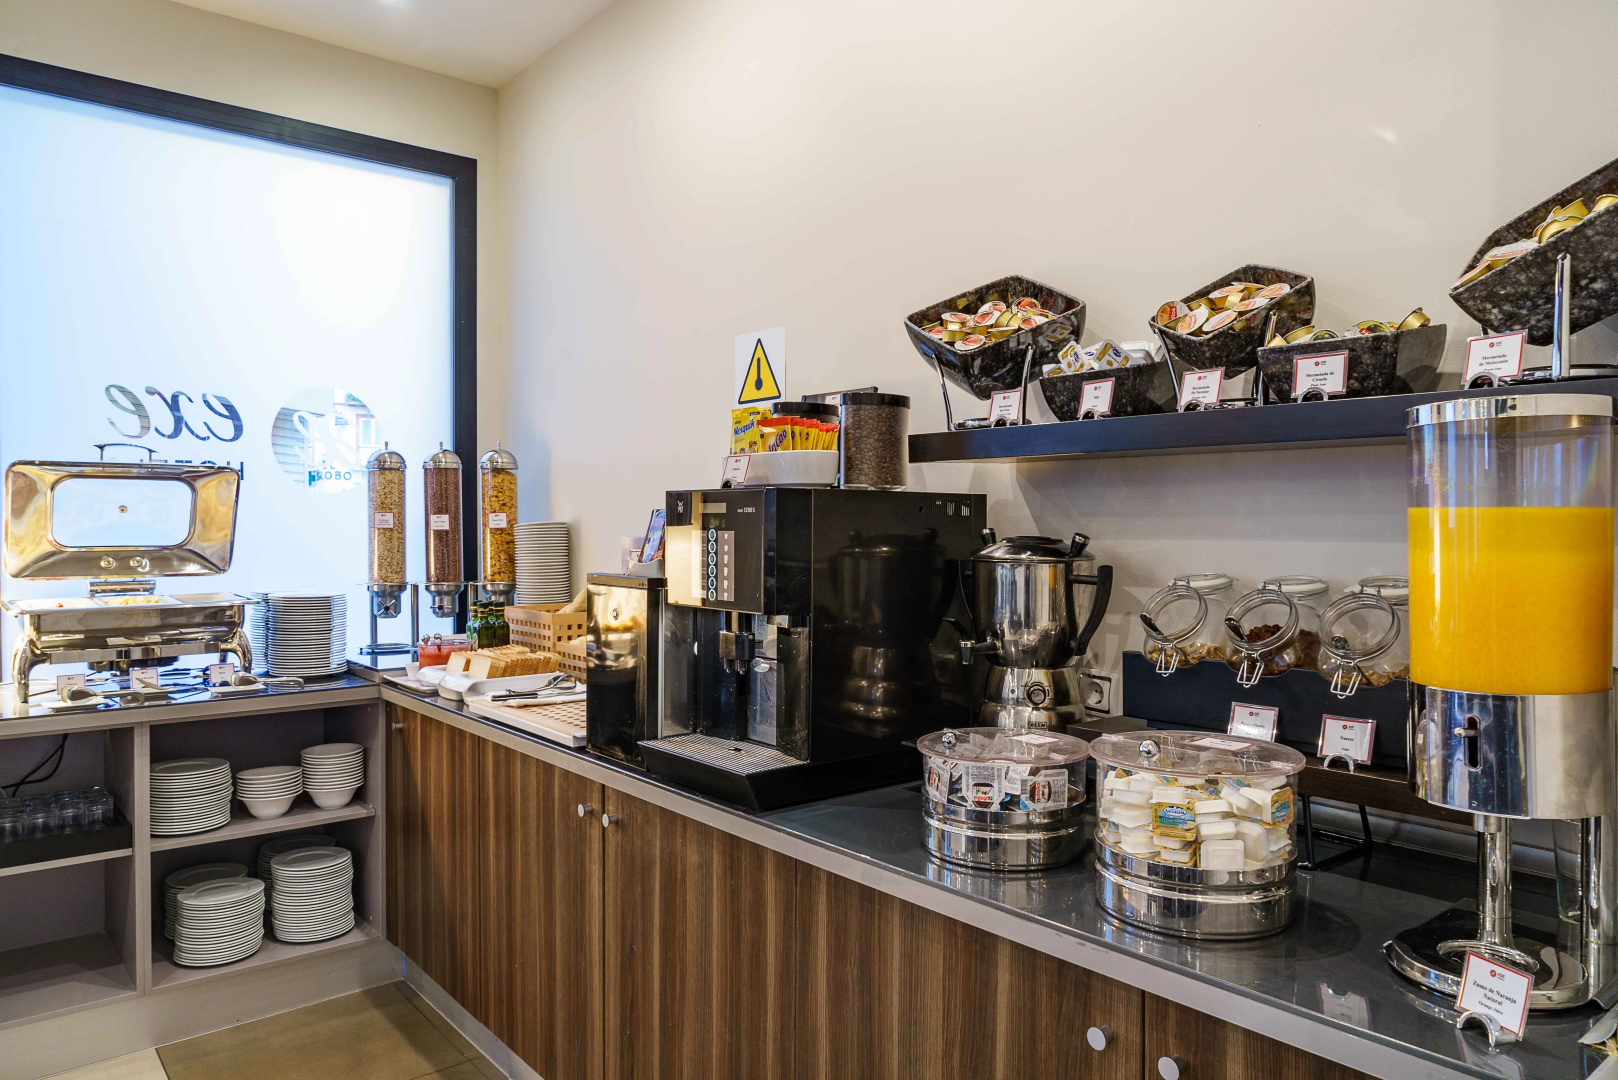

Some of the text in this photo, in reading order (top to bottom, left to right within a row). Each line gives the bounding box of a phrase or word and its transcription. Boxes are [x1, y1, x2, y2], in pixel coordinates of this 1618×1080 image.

[733, 418, 756, 437] Nesquik
[1472, 979, 1488, 991] Zumo
[1495, 990, 1517, 1005] Naranja
[1483, 992, 1503, 1007] Natural
